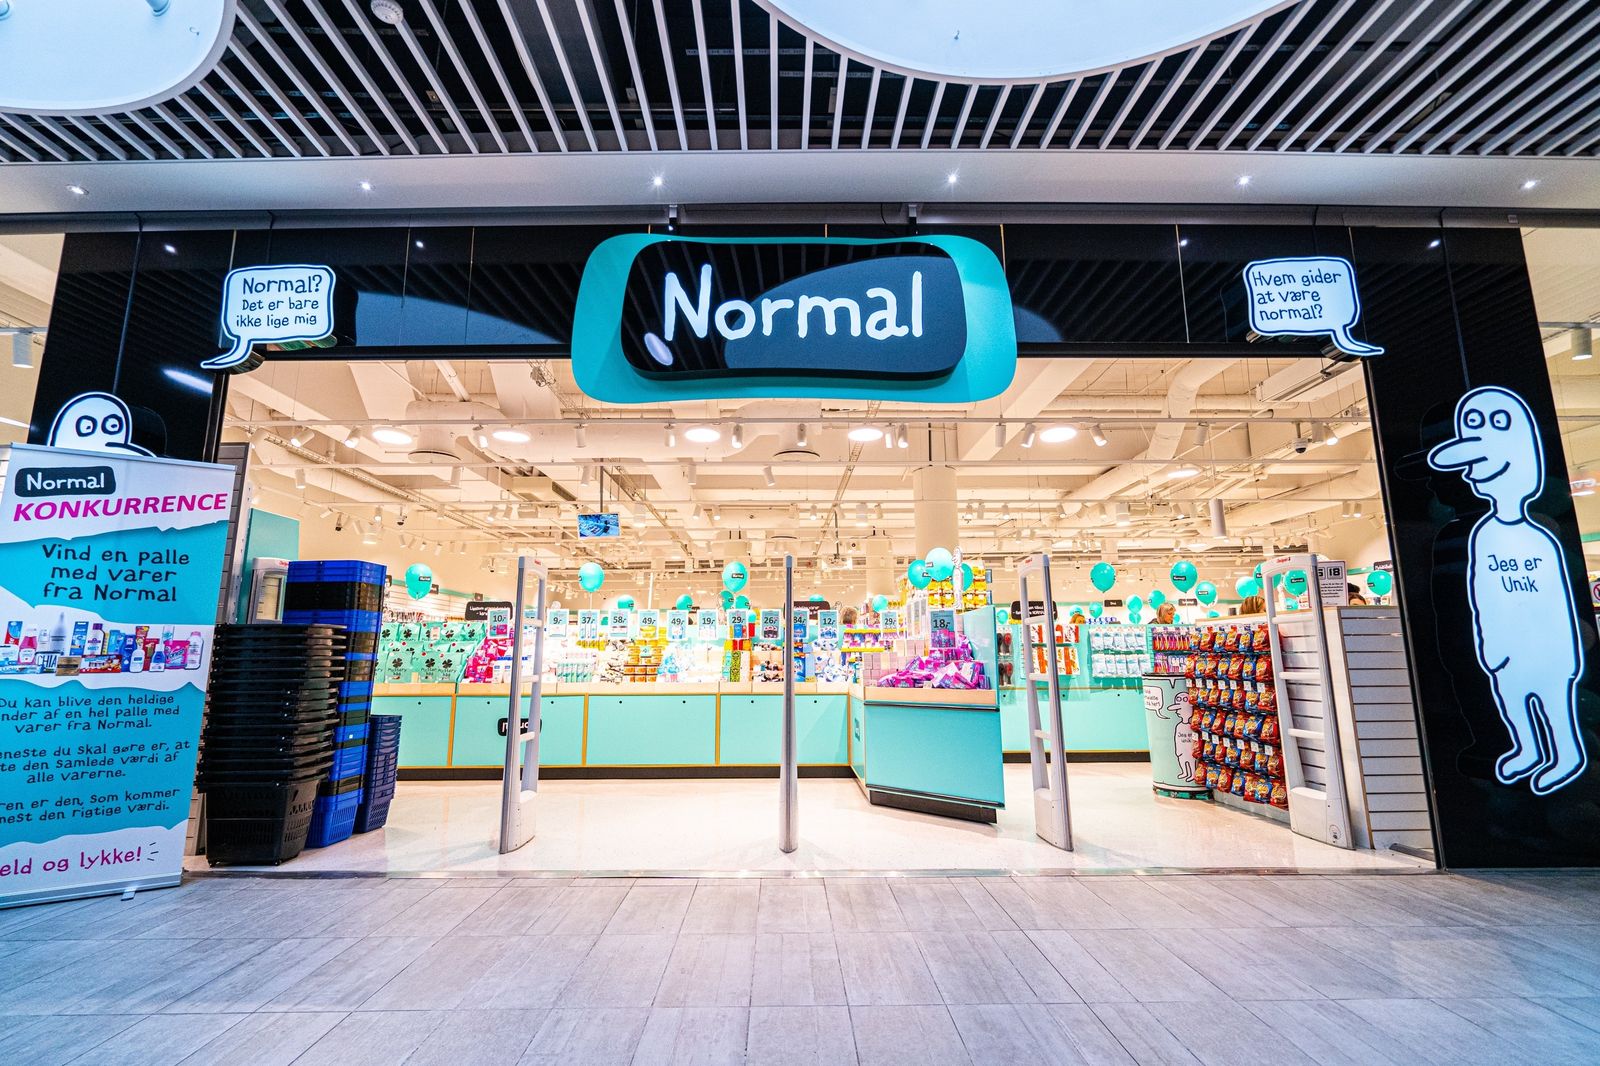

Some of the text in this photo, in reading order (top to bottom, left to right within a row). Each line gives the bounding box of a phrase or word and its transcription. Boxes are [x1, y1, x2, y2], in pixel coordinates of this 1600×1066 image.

[243, 274, 322, 295] Normal?
[1252, 268, 1342, 287] Hvem gider
[242, 297, 319, 311] Det er bare
[664, 264, 923, 341] Normal
[1256, 290, 1321, 305] at være
[236, 313, 317, 328] ikke lige mig
[1259, 303, 1323, 321] normal?
[26, 472, 105, 491] Normal
[13, 493, 228, 522] KONKURRENCE
[42, 544, 190, 566] Vind en palle
[1487, 554, 1542, 572] Jeg er
[50, 565, 177, 583] med varer
[43, 582, 177, 602] fra Normal
[1501, 576, 1539, 592] Unik
[24, 697, 51, 708] kan
[58, 695, 92, 707] blive
[97, 695, 122, 706] den
[128, 694, 174, 706] heldige
[44, 708, 61, 720] af
[65, 709, 82, 719] en
[89, 707, 110, 718] hel
[115, 706, 148, 721] palle
[153, 705, 180, 716] med
[15, 719, 152, 733] varer fra Normal.
[53, 746, 71, 757] du
[77, 743, 107, 755] skal
[113, 744, 145, 756] gøre
[151, 743, 170, 753] er,
[175, 740, 190, 750] at
[23, 760, 50, 771] den
[55, 756, 114, 769] samlede
[120, 754, 159, 765] værdi
[164, 751, 179, 762] af
[26, 769, 126, 784] alle varerne.
[31, 799, 49, 809] er
[55, 797, 84, 808] den,
[90, 794, 118, 804] som
[125, 788, 180, 801] kommer
[39, 810, 65, 821] den
[72, 806, 122, 818] rigtige
[128, 803, 170, 813] værdi.
[43, 858, 69, 872] og
[80, 846, 141, 870] lykke!
